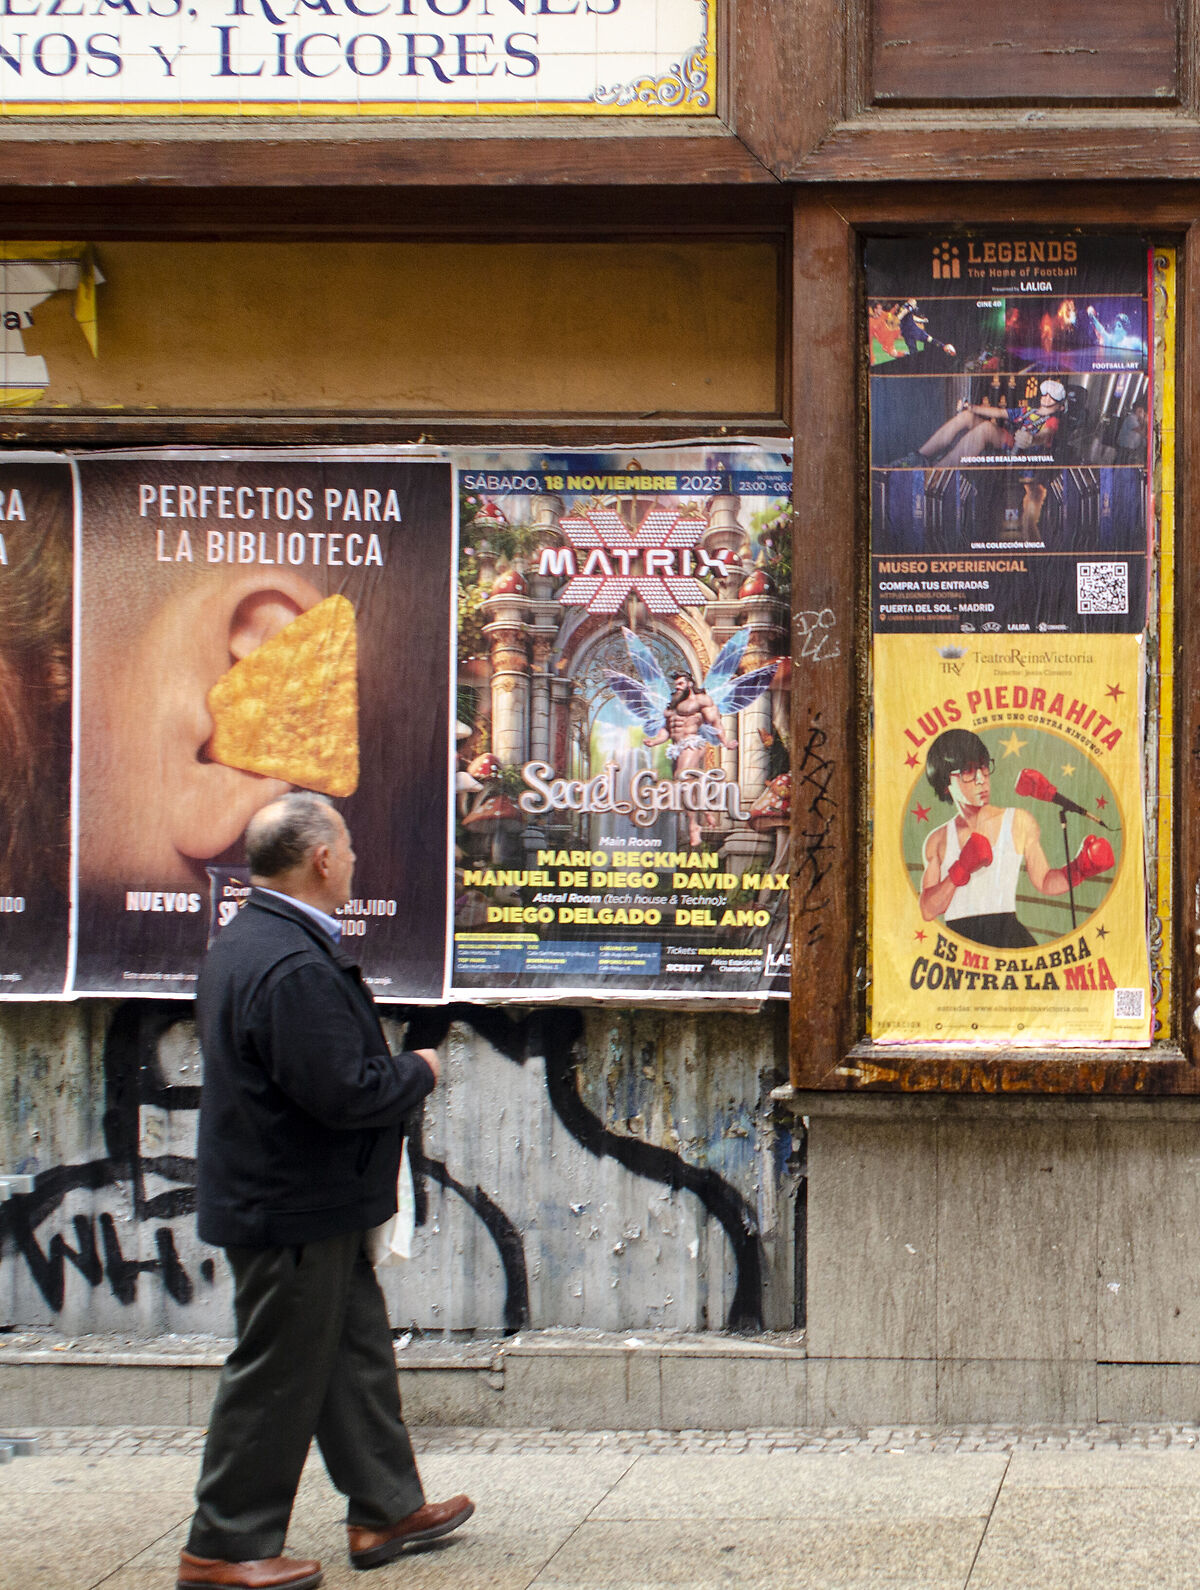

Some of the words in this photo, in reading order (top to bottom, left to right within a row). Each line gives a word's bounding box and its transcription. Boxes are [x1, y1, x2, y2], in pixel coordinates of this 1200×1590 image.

[210, 25, 541, 84] LICORES
[968, 241, 1078, 264] LEGENDS
[968, 268, 986, 278] The
[988, 268, 1016, 278] Home
[1019, 267, 1030, 277] of
[1034, 266, 1078, 277] Football
[1020, 281, 1053, 292] LALIGA
[464, 473, 541, 492] SÁBADO,
[545, 474, 561, 491] 18
[566, 474, 678, 491] NOVIEMBRE
[681, 476, 723, 492] 2023
[139, 484, 314, 521] PERFECTOS
[325, 488, 402, 522] PARA
[156, 530, 193, 562] LA
[207, 531, 384, 567] BIBLIOTECA
[538, 548, 729, 577] MATRIX
[878, 561, 928, 574] MUSEO
[930, 560, 1028, 573] EXPERIENCIAL
[879, 581, 920, 591] COMPRA
[921, 580, 939, 590] TUS
[940, 580, 990, 590] ENTRADAS
[880, 604, 914, 614] PUERTA
[915, 604, 931, 613] DEL
[933, 603, 952, 613] SOL
[959, 603, 995, 613] MADRID
[903, 699, 963, 749] LUIS
[966, 686, 1124, 751] PIEDRAHITA
[1027, 714, 1063, 731] CONTRA
[630, 768, 751, 827] Garden
[598, 836, 624, 848] Main
[627, 837, 662, 848] Room
[537, 850, 608, 867] MARIO
[611, 851, 719, 869] BECKMAN
[463, 870, 556, 888] MANUEL
[558, 871, 589, 888] DE
[591, 872, 659, 889] DIEGO
[672, 873, 739, 890] DAVID
[126, 891, 201, 913] NUEVOS
[532, 892, 566, 904] Astral
[568, 893, 601, 904] Room
[635, 894, 667, 905] house
[669, 895, 679, 905] &
[487, 906, 555, 923] DIEGO
[558, 907, 662, 925] DELGADO
[675, 909, 718, 926] DEL
[720, 910, 771, 927] AMO
[933, 932, 958, 962] ES
[962, 949, 989, 971] MI
[995, 937, 1092, 972] PALABRA
[910, 956, 1016, 991] CONTRA
[1024, 972, 1060, 991] LA
